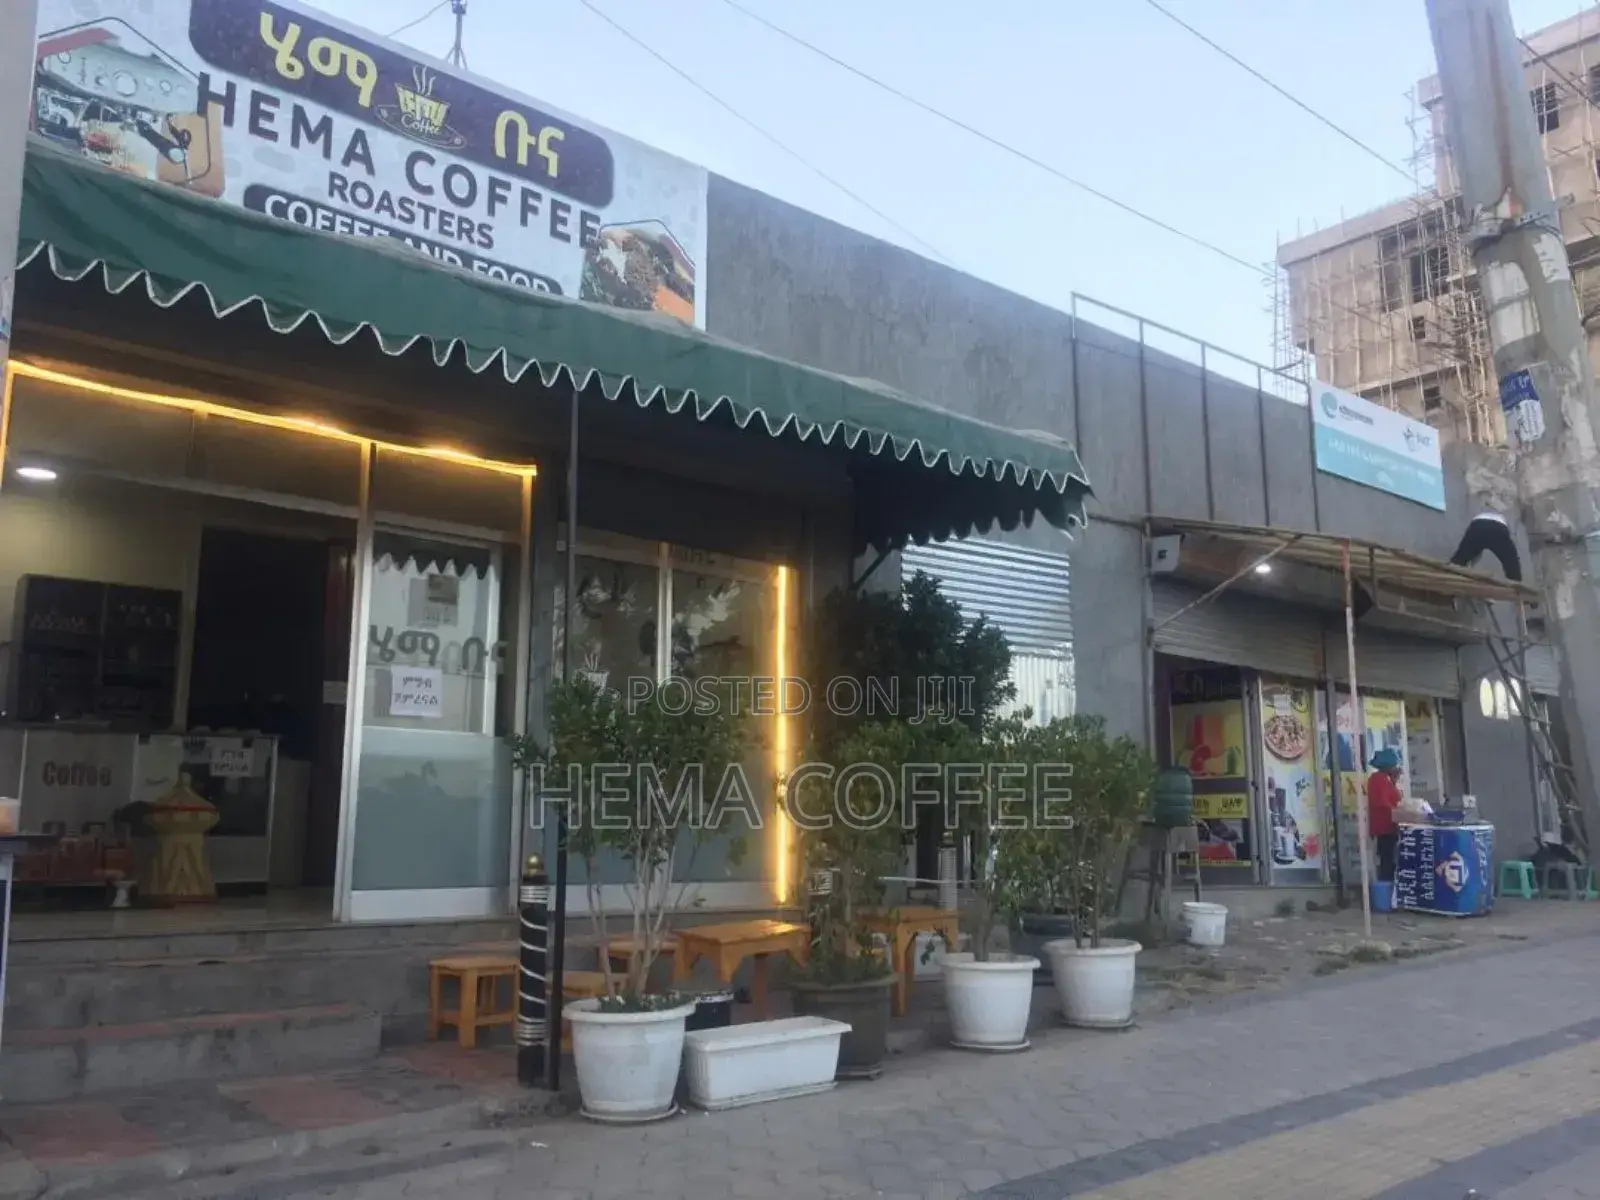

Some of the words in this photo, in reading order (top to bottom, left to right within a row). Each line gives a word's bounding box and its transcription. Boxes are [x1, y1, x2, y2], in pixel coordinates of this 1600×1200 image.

[260, 11, 378, 108] ሄማ
[494, 109, 565, 178] ቡና
[196, 71, 376, 177] HEMA
[404, 150, 601, 250] COFFEE
[328, 170, 494, 250] ROASTERS
[369, 624, 441, 667] ሄማ
